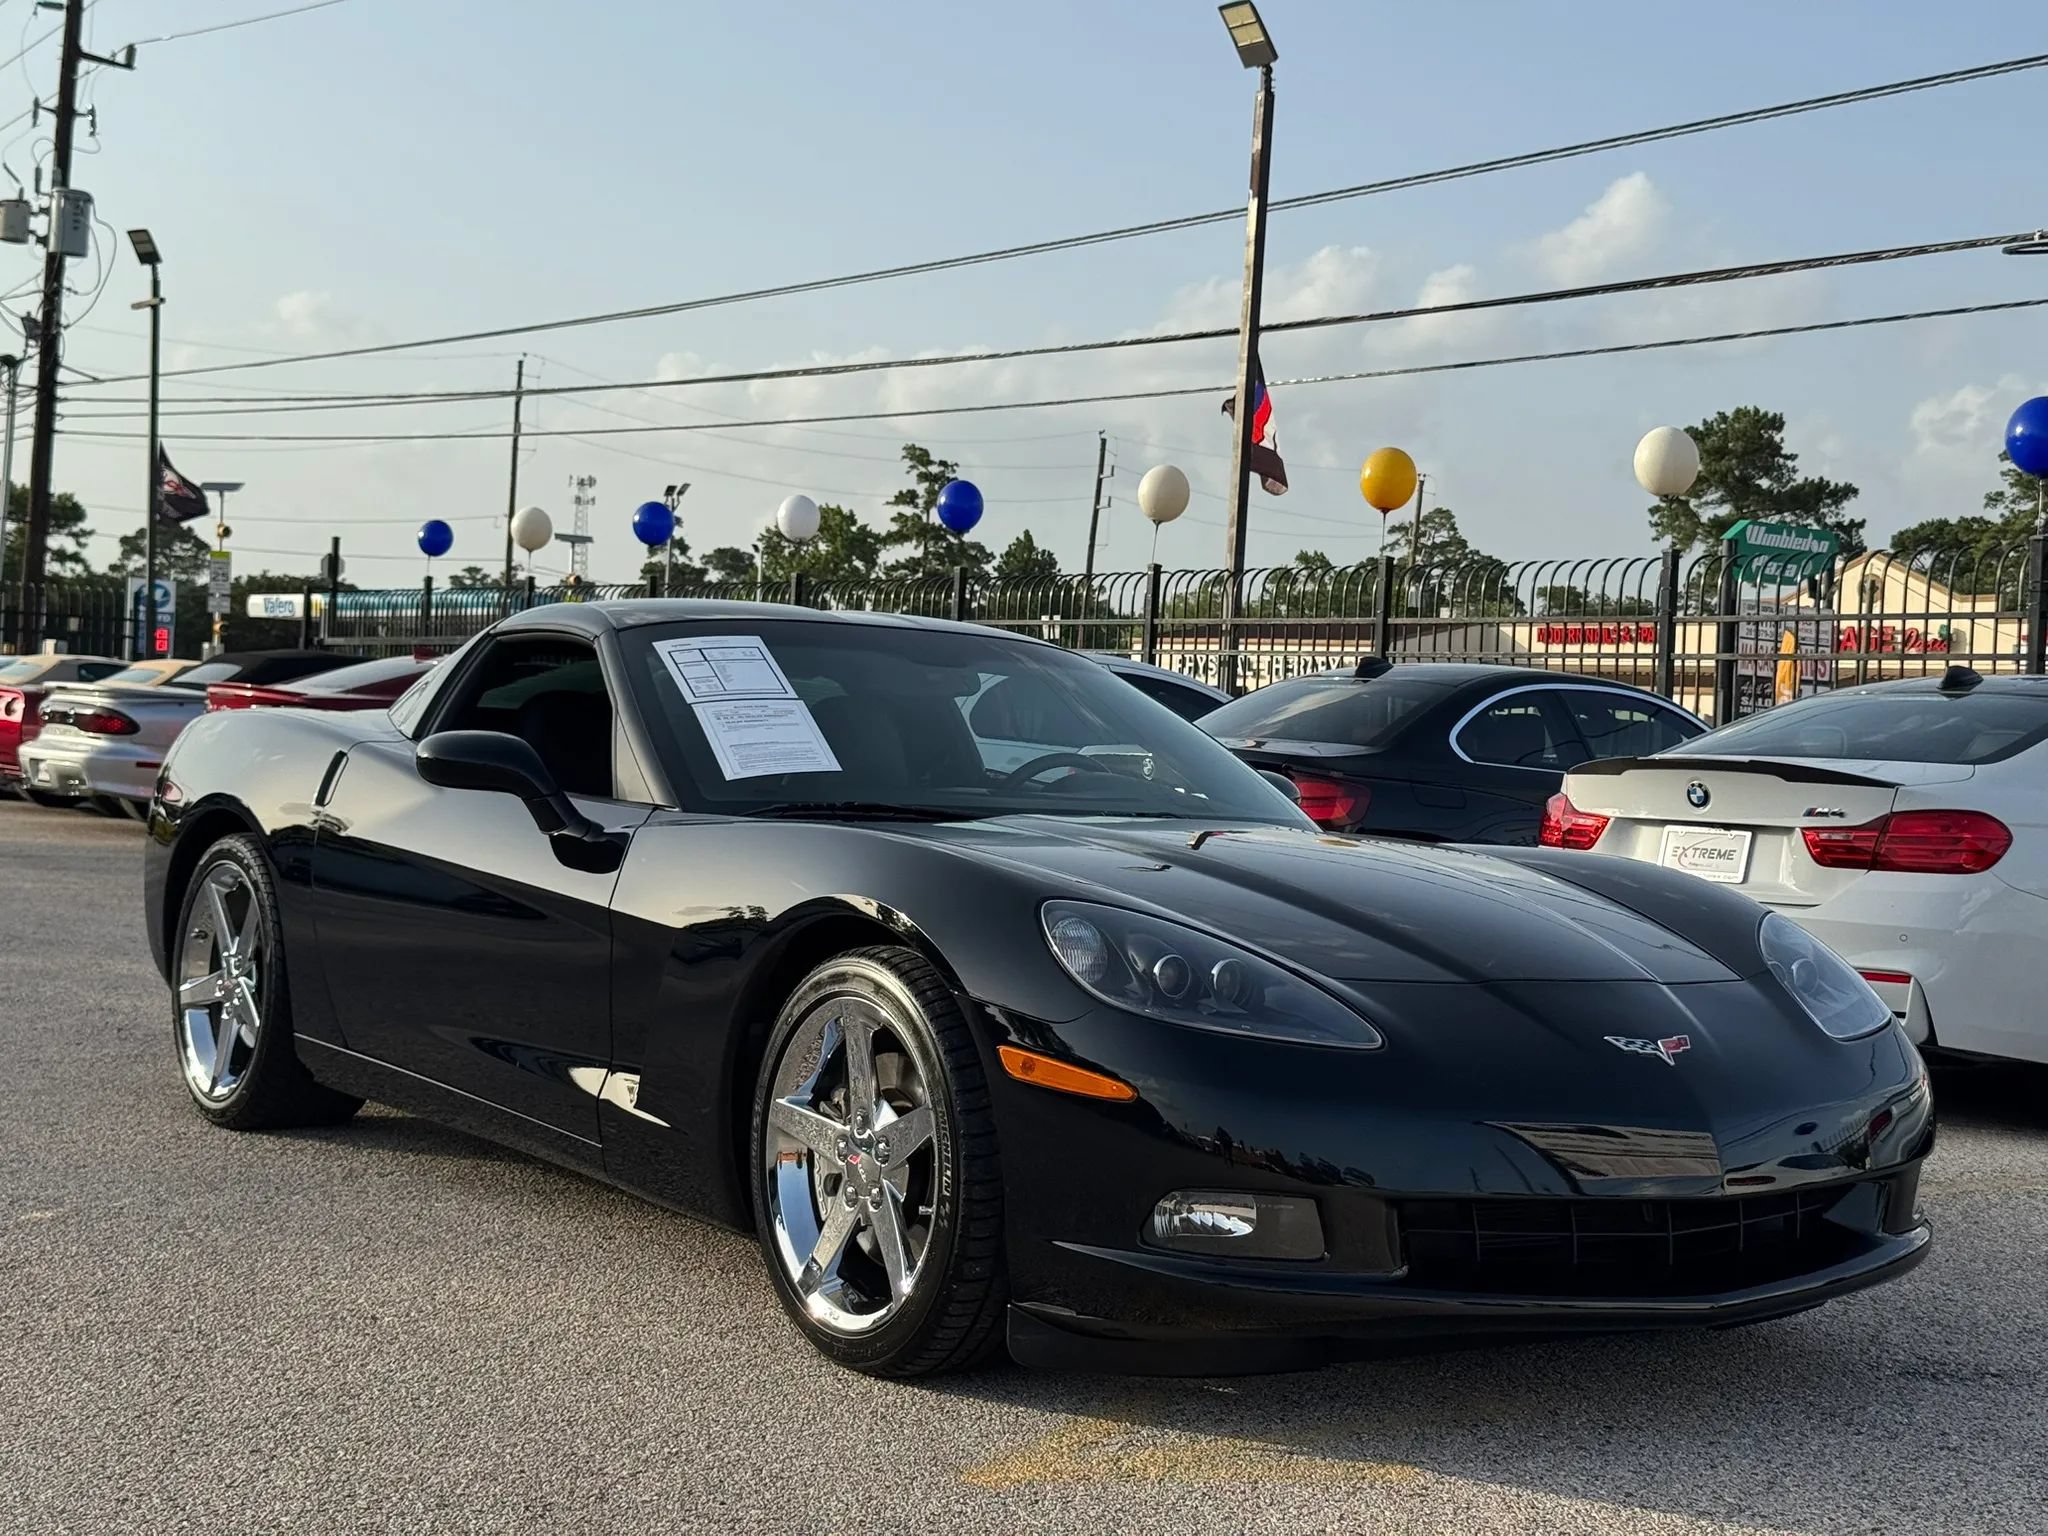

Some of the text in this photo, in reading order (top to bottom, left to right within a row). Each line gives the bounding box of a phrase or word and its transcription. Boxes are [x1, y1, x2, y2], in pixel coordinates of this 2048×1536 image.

[1745, 524, 1830, 553] Wimbledon
[1751, 555, 1798, 578] Paza
[1671, 846, 1737, 861] EXTREME
